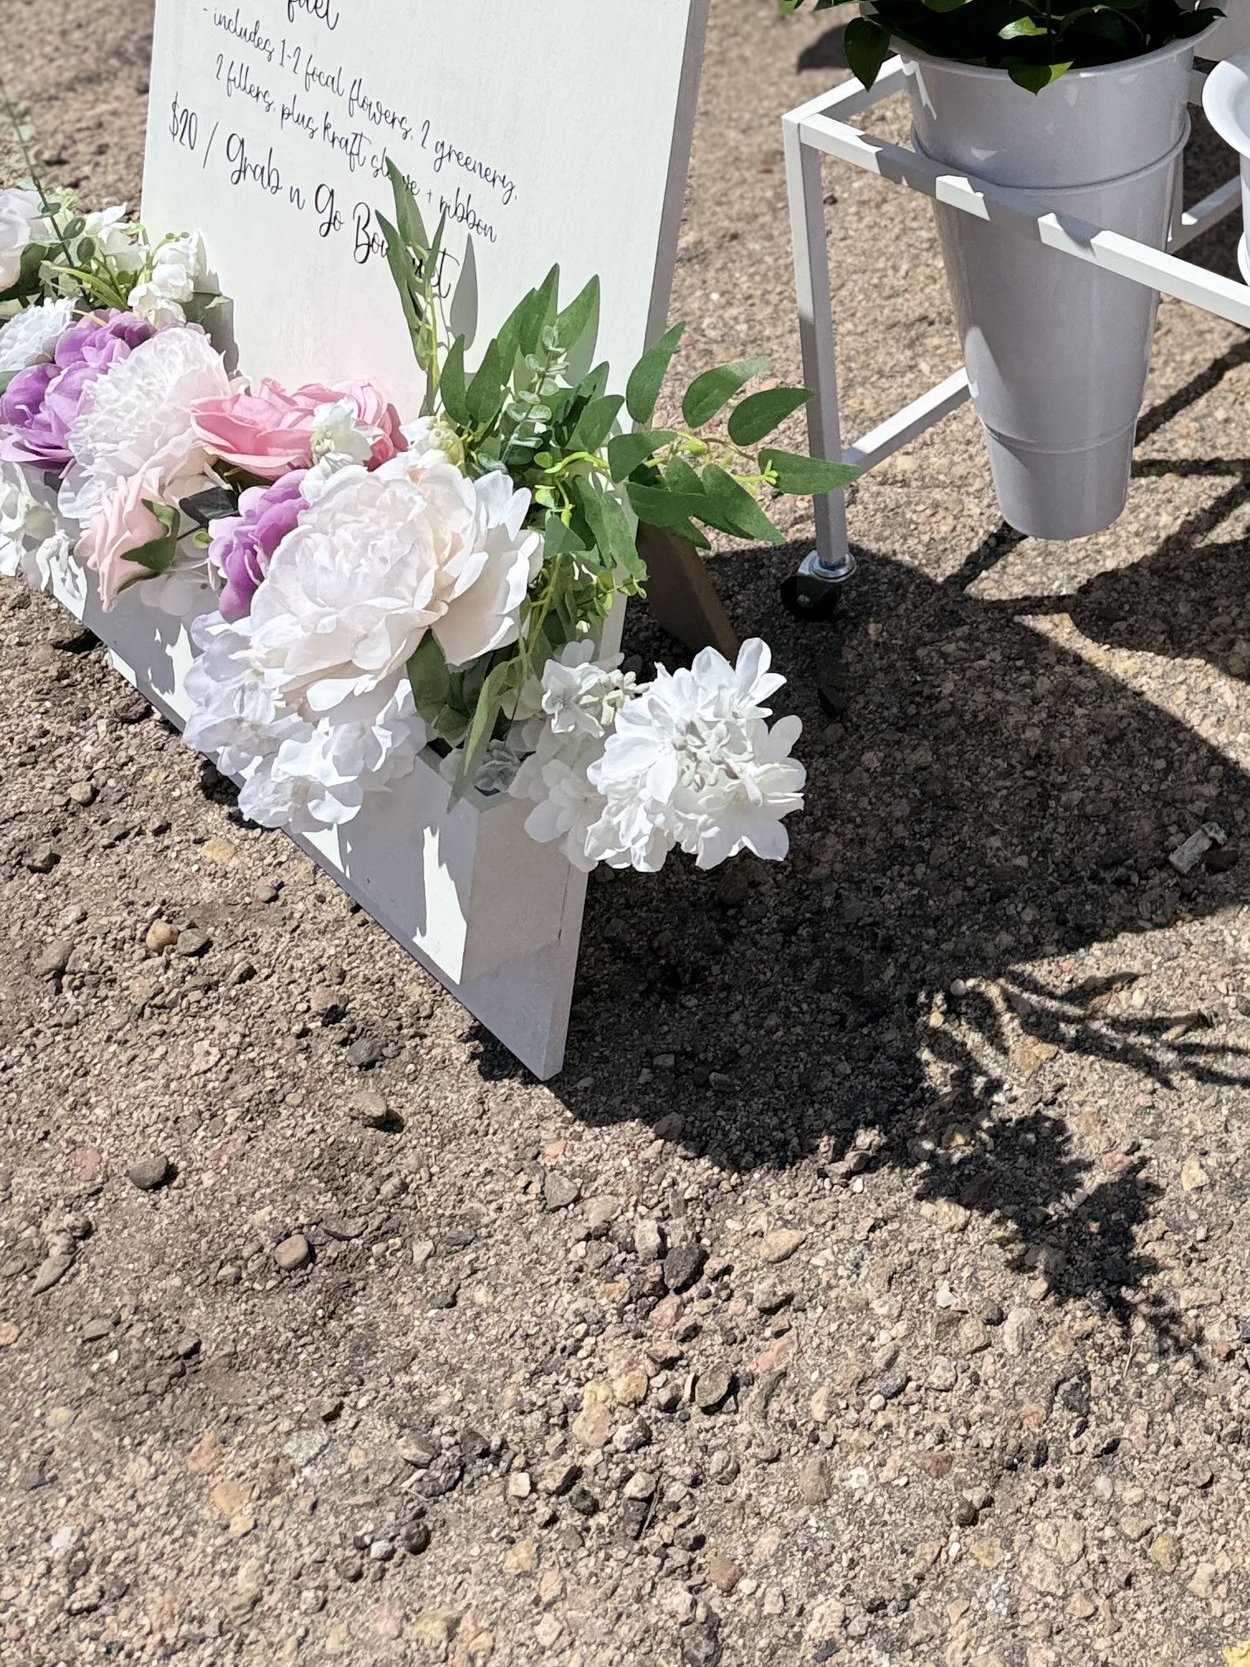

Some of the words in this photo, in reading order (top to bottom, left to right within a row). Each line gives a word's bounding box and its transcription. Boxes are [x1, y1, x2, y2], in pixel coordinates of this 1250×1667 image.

[213, 7, 276, 62] includes
[279, 38, 302, 75] 1-2
[304, 53, 346, 97] focal
[420, 119, 431, 150] 2
[215, 53, 224, 81] 2
[280, 93, 319, 140] plus
[322, 110, 372, 173] kraft
[370, 146, 421, 196] slve
[438, 186, 498, 244] ribbon
[169, 91, 199, 151] $20
[289, 184, 306, 211] n
[352, 201, 460, 299] Bouut
